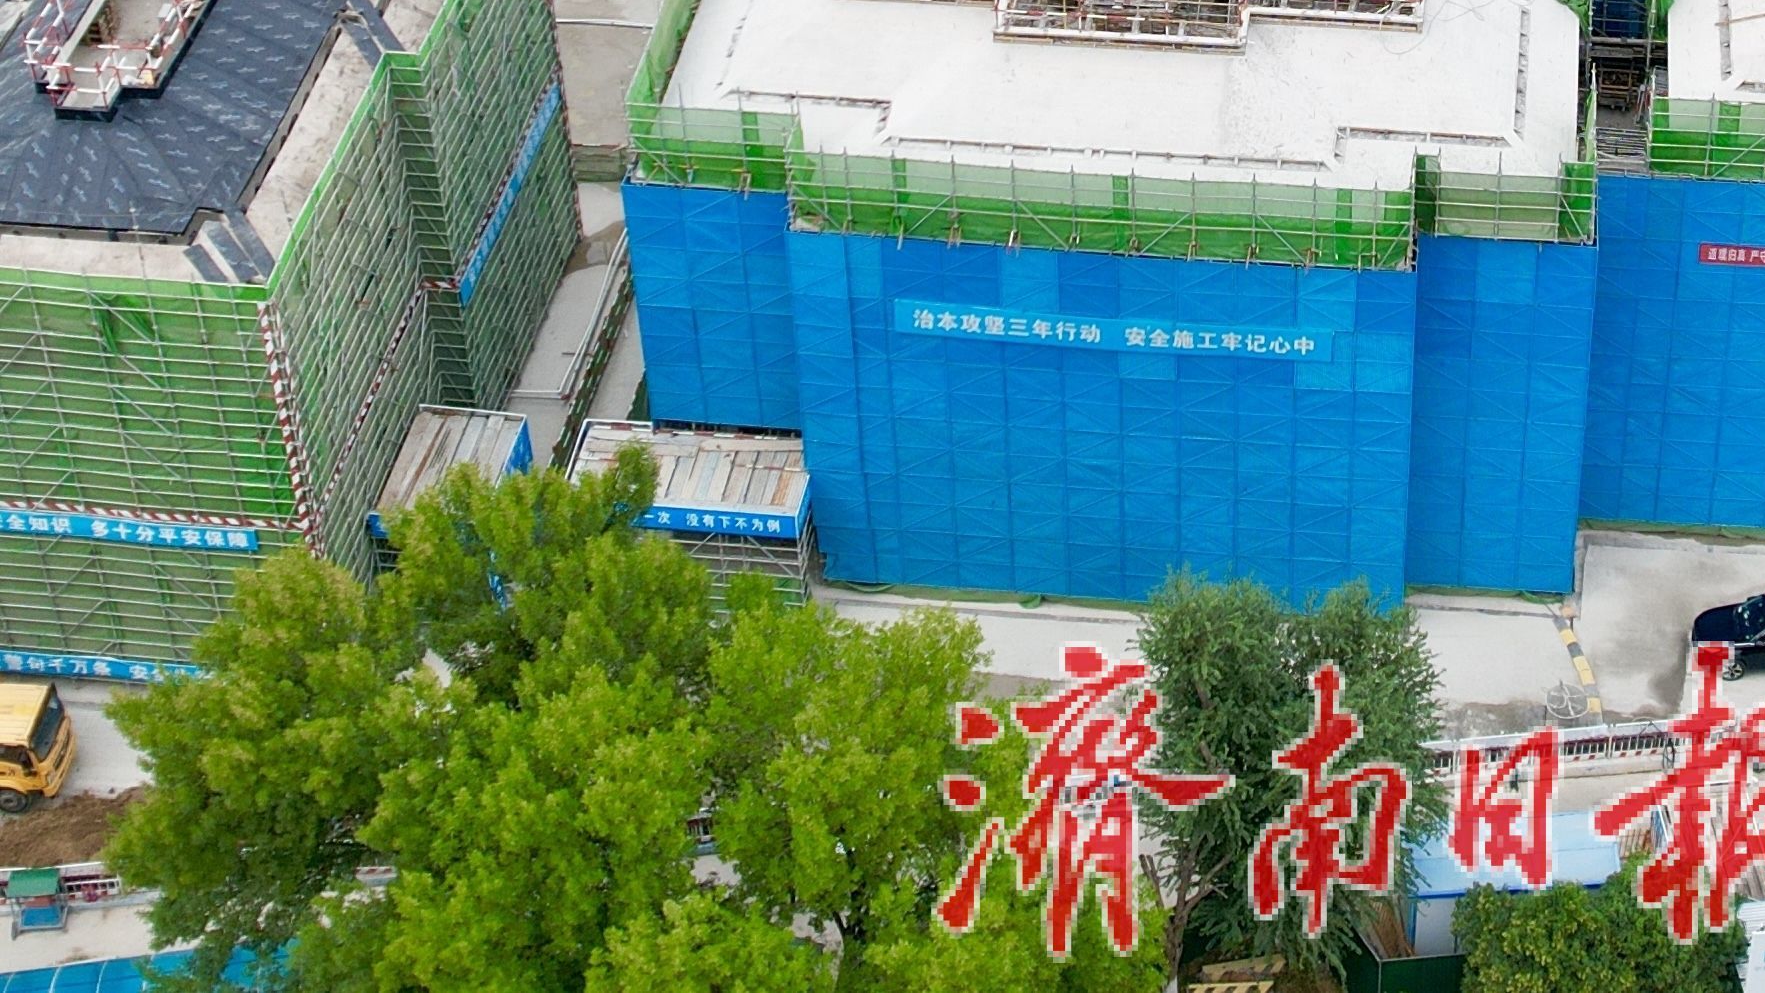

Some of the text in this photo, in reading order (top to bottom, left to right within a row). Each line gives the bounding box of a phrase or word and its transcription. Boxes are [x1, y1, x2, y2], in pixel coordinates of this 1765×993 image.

[913, 308, 1316, 356] 治本攻坚三年行动 安全施工牢记心中
[0, 513, 250, 548] 全知识 多十分平安保障
[686, 512, 782, 534] 没有下不为例
